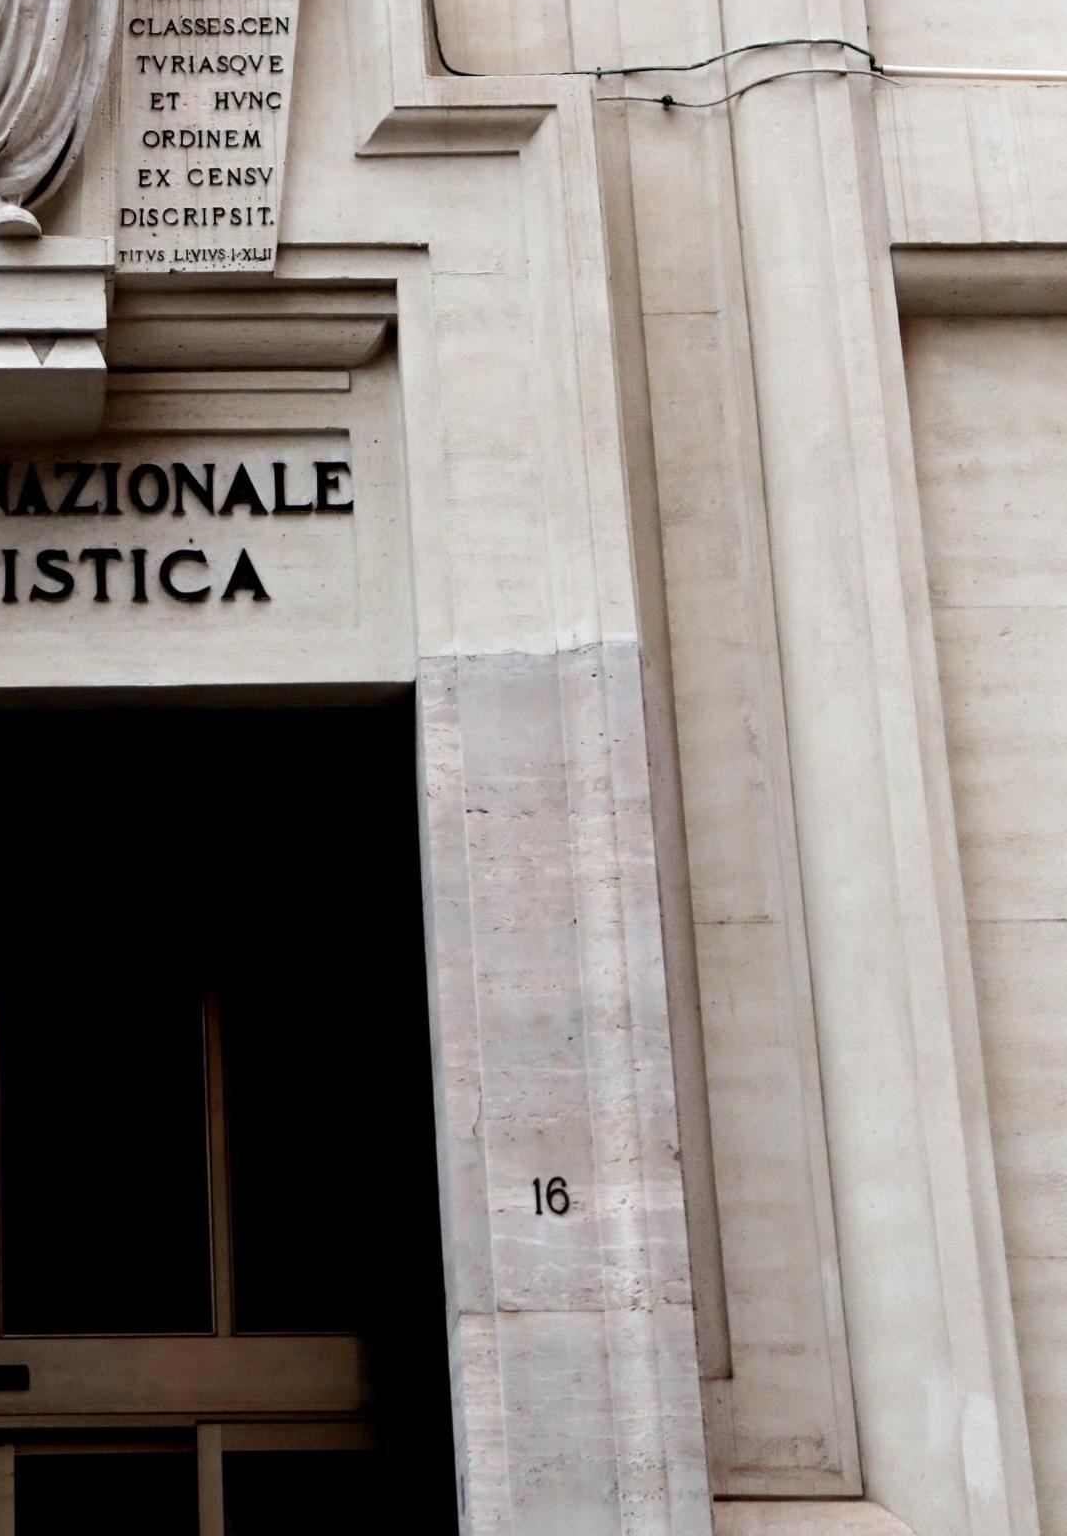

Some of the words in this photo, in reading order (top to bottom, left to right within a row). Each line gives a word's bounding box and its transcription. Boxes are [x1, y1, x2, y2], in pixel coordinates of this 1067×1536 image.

[136, 55, 284, 76] TVRIASQVE
[150, 92, 180, 111] ET
[215, 91, 282, 111] HVNC
[142, 130, 262, 149] ORDINEM
[138, 168, 171, 187] EX
[187, 167, 274, 187] CENSV
[120, 207, 275, 227] DISCRIPSIT.
[118, 249, 165, 262] TITVS
[174, 249, 226, 262] LIVIVS
[532, 1176, 570, 1215] 16
